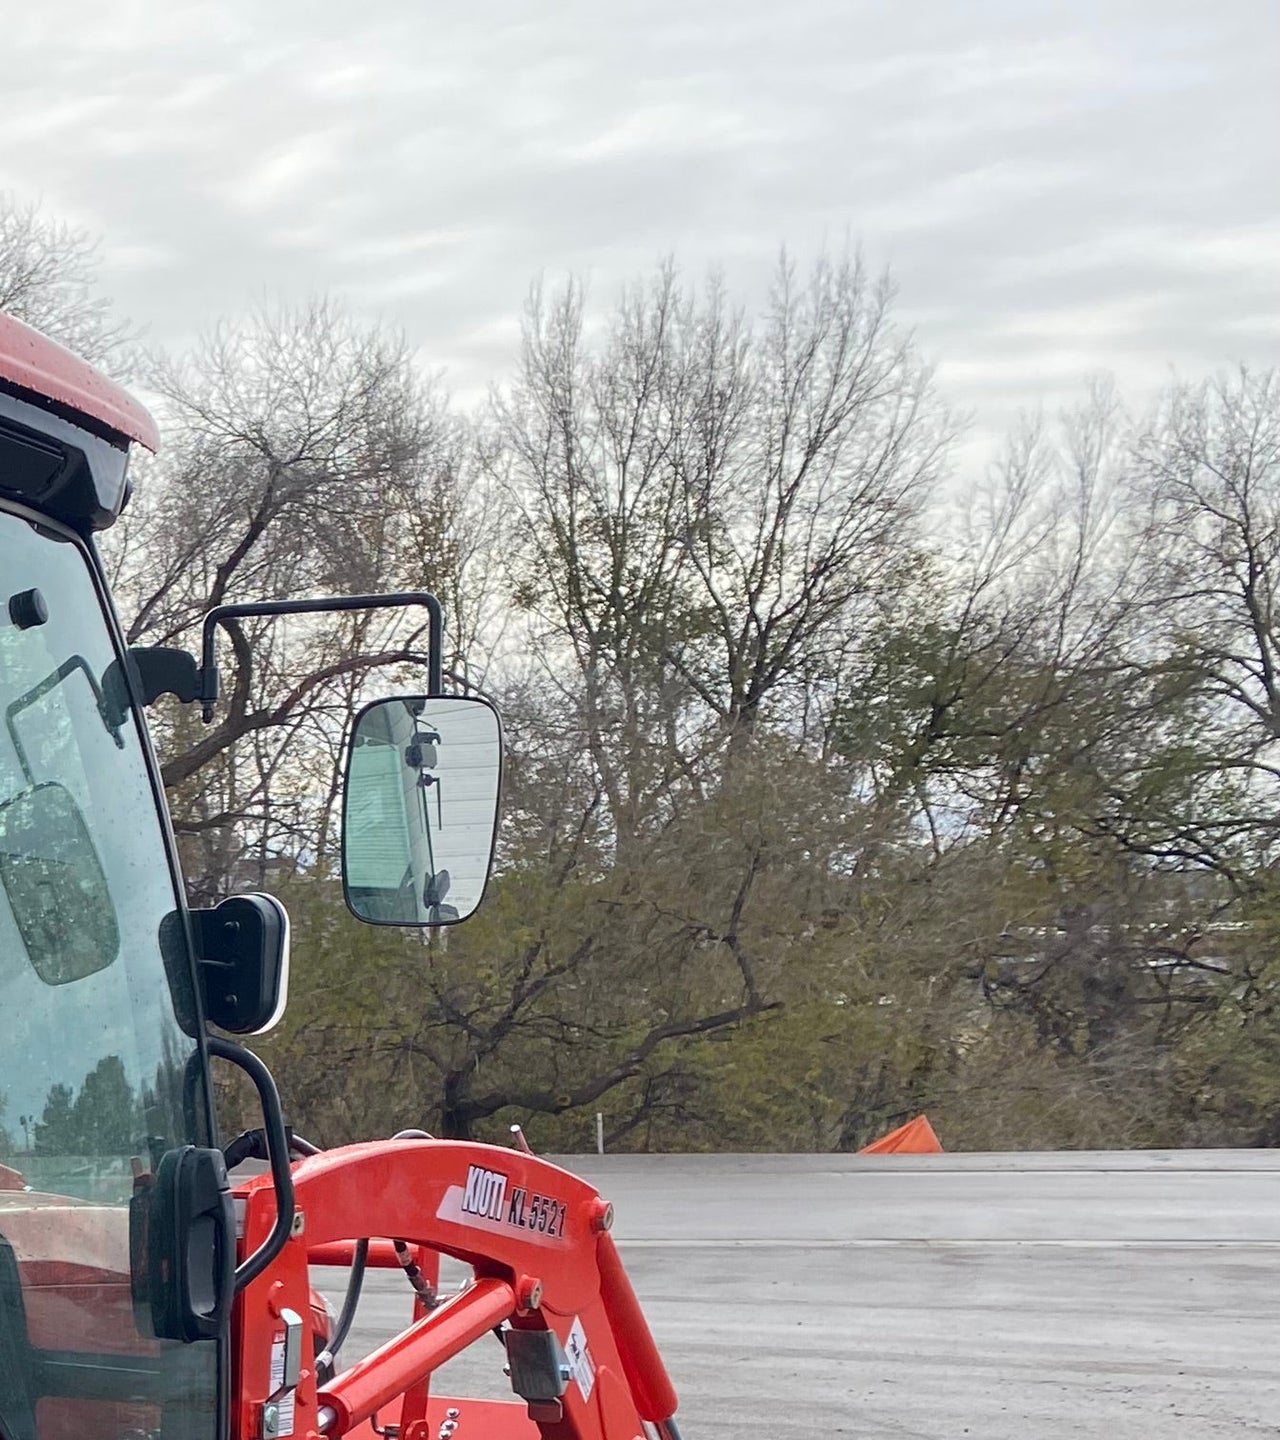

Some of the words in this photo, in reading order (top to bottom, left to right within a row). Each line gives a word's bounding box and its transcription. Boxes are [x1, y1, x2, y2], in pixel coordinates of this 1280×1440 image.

[461, 1163, 508, 1222] KIOTI
[508, 1187, 527, 1228] KL
[529, 1193, 567, 1238] 5521
